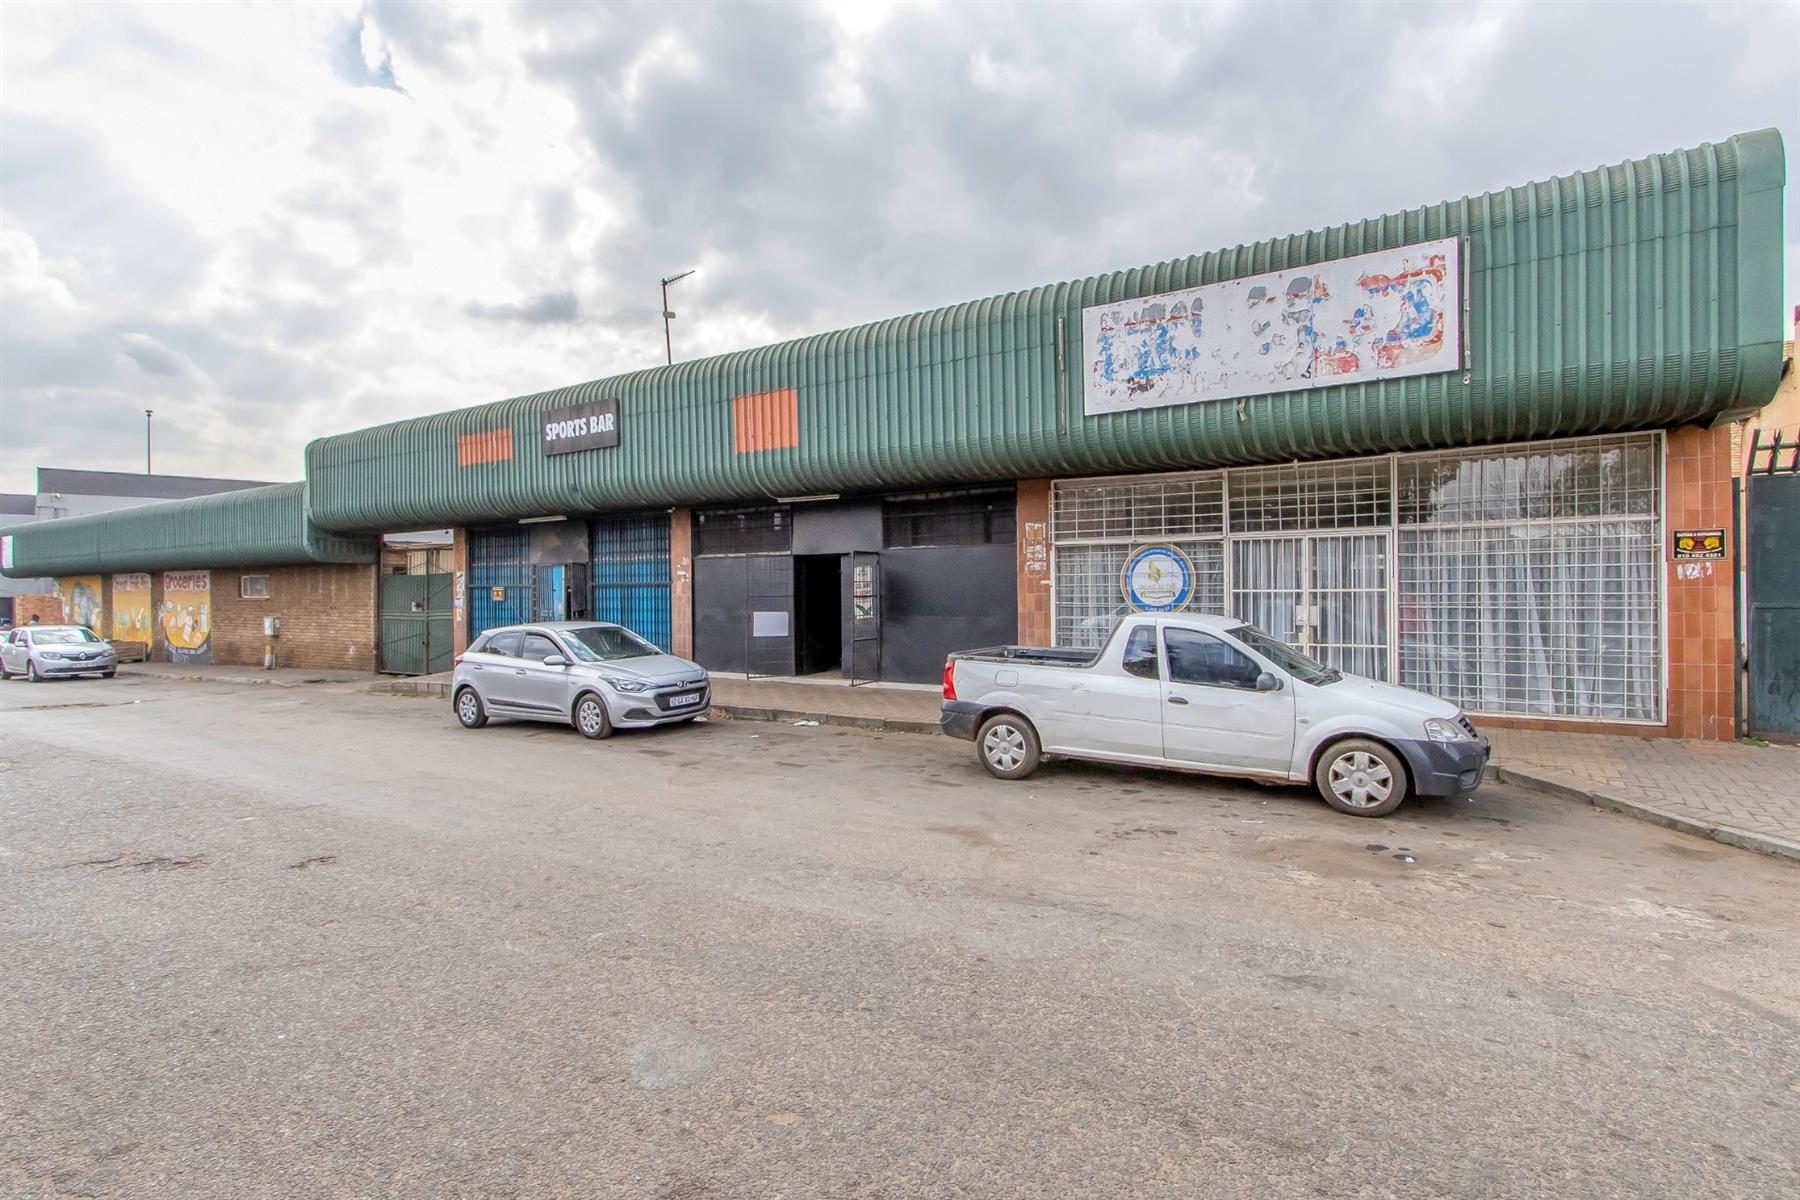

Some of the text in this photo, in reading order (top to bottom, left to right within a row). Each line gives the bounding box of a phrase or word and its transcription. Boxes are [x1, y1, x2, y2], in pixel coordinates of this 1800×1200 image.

[545, 413, 614, 441] SPORTS BAR
[165, 574, 208, 591] Groceries
